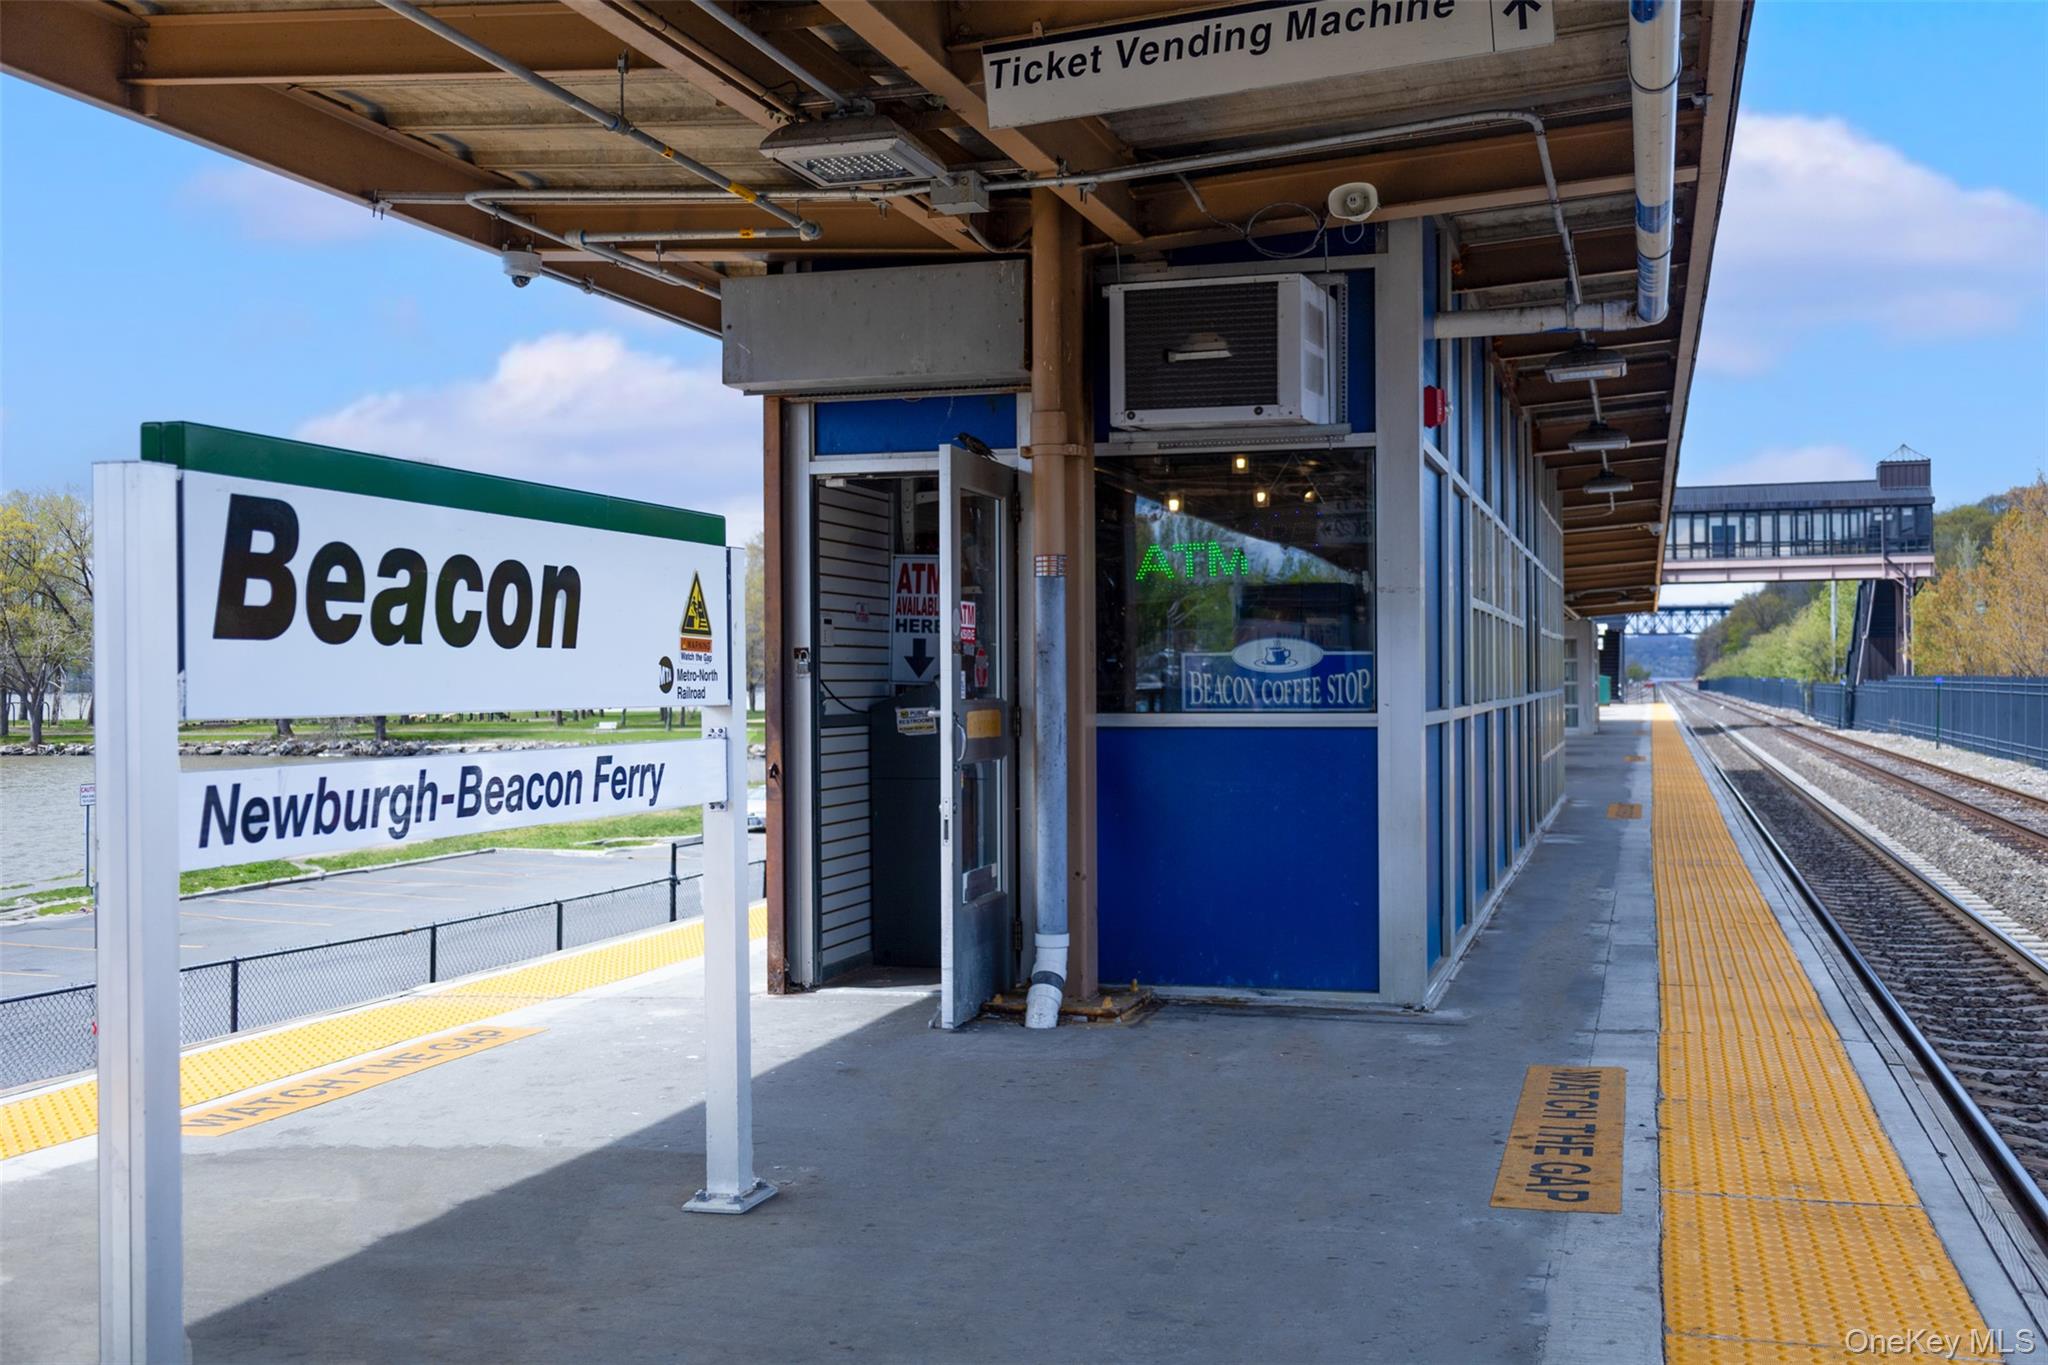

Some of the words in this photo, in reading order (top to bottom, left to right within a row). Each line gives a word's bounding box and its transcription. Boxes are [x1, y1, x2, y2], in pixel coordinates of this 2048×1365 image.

[989, 45, 1102, 90] Ticket
[1115, 20, 1272, 70] Vending
[1285, 0, 1456, 43] Machine
[213, 493, 582, 650] Beacon
[896, 563, 940, 594] ATM
[1135, 539, 1249, 581] ATM
[895, 596, 940, 616] AVAILABL
[677, 668, 718, 681] Metro-North
[677, 686, 706, 699] Railroad
[1190, 671, 1257, 705] BEACON
[1261, 676, 1321, 704] COFFEE
[1327, 668, 1371, 704] STOP
[199, 765, 582, 849] Newburgh-Beacon
[593, 755, 665, 807] Ferry
[182, 1080, 343, 1129] WATCH
[341, 1052, 442, 1082] THE
[428, 1029, 502, 1054] GAP
[1542, 1071, 1601, 1119] WATCH
[1534, 1124, 1596, 1157] THE
[1525, 1162, 1592, 1202] GAP
